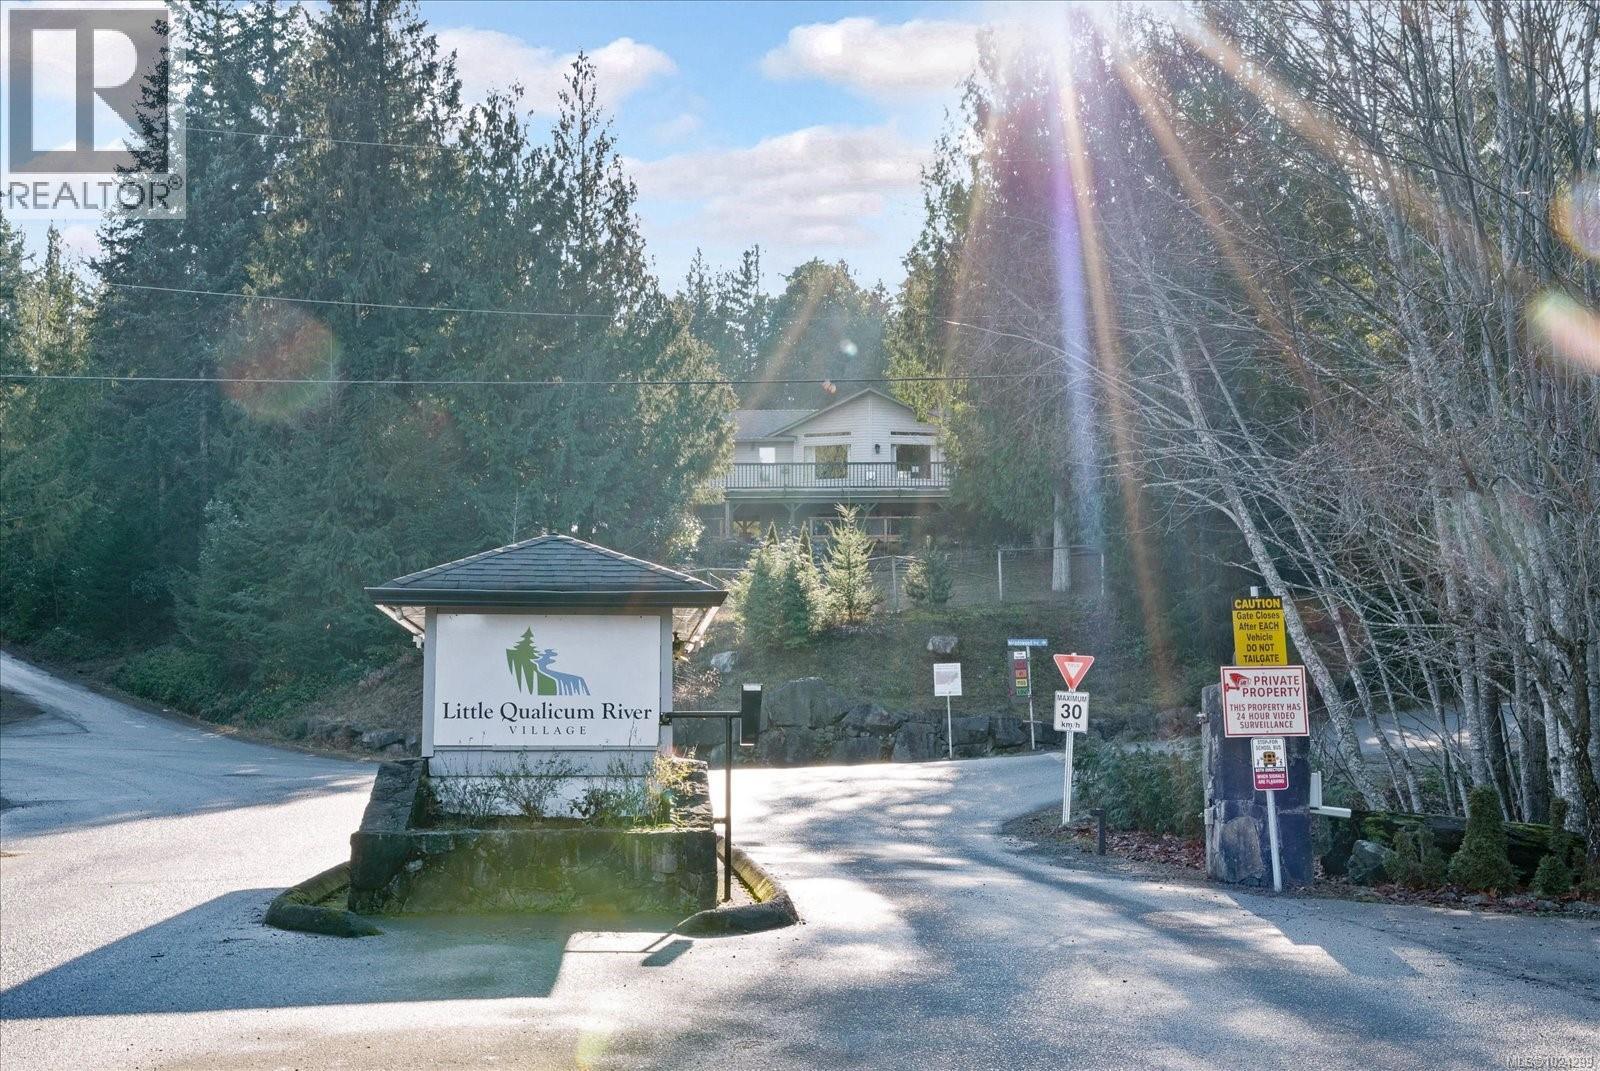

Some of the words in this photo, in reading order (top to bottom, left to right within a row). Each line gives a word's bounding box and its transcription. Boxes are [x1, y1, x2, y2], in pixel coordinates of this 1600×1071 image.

[1234, 598, 1281, 609] CAUTION
[1236, 611, 1254, 620] Gate
[1255, 611, 1280, 620] Closes
[1239, 622, 1257, 631] After
[1258, 622, 1279, 631] EACH
[1246, 633, 1273, 641] Vehicle
[1246, 644, 1257, 652] DO
[1259, 643, 1274, 652] NOT
[1243, 654, 1280, 663] TAILGATE
[1253, 675, 1300, 686] PRIVATE
[1242, 687, 1300, 698] PROPERTY
[1056, 694, 1087, 702] MAXIMUM
[1230, 703, 1246, 711] THIS
[1247, 703, 1285, 711] PROPERTY
[1286, 702, 1302, 711] HAS
[443, 702, 493, 720] Little
[500, 702, 595, 722] Qualicum
[602, 702, 652, 720] River
[1060, 703, 1082, 720] 30
[1248, 712, 1270, 720] HOUR
[1272, 711, 1296, 720] VIDEO
[1240, 720, 1294, 729] SURVEILLANCE
[509, 725, 587, 735] VILLAGE
